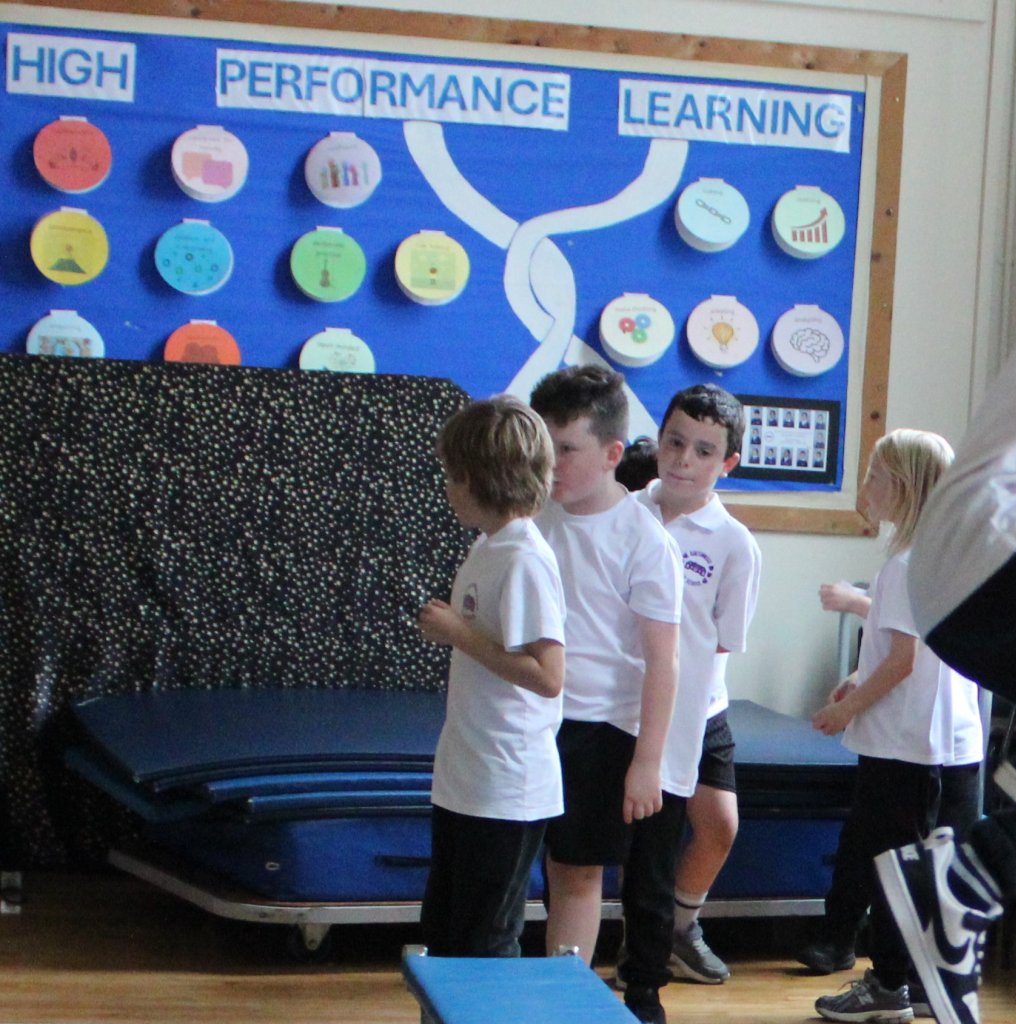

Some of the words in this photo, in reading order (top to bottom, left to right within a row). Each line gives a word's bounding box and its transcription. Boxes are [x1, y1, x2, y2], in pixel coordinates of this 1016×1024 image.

[12, 44, 128, 90] HIGH
[219, 58, 565, 118] PERFORMANCE
[623, 87, 846, 138] LEARNING
